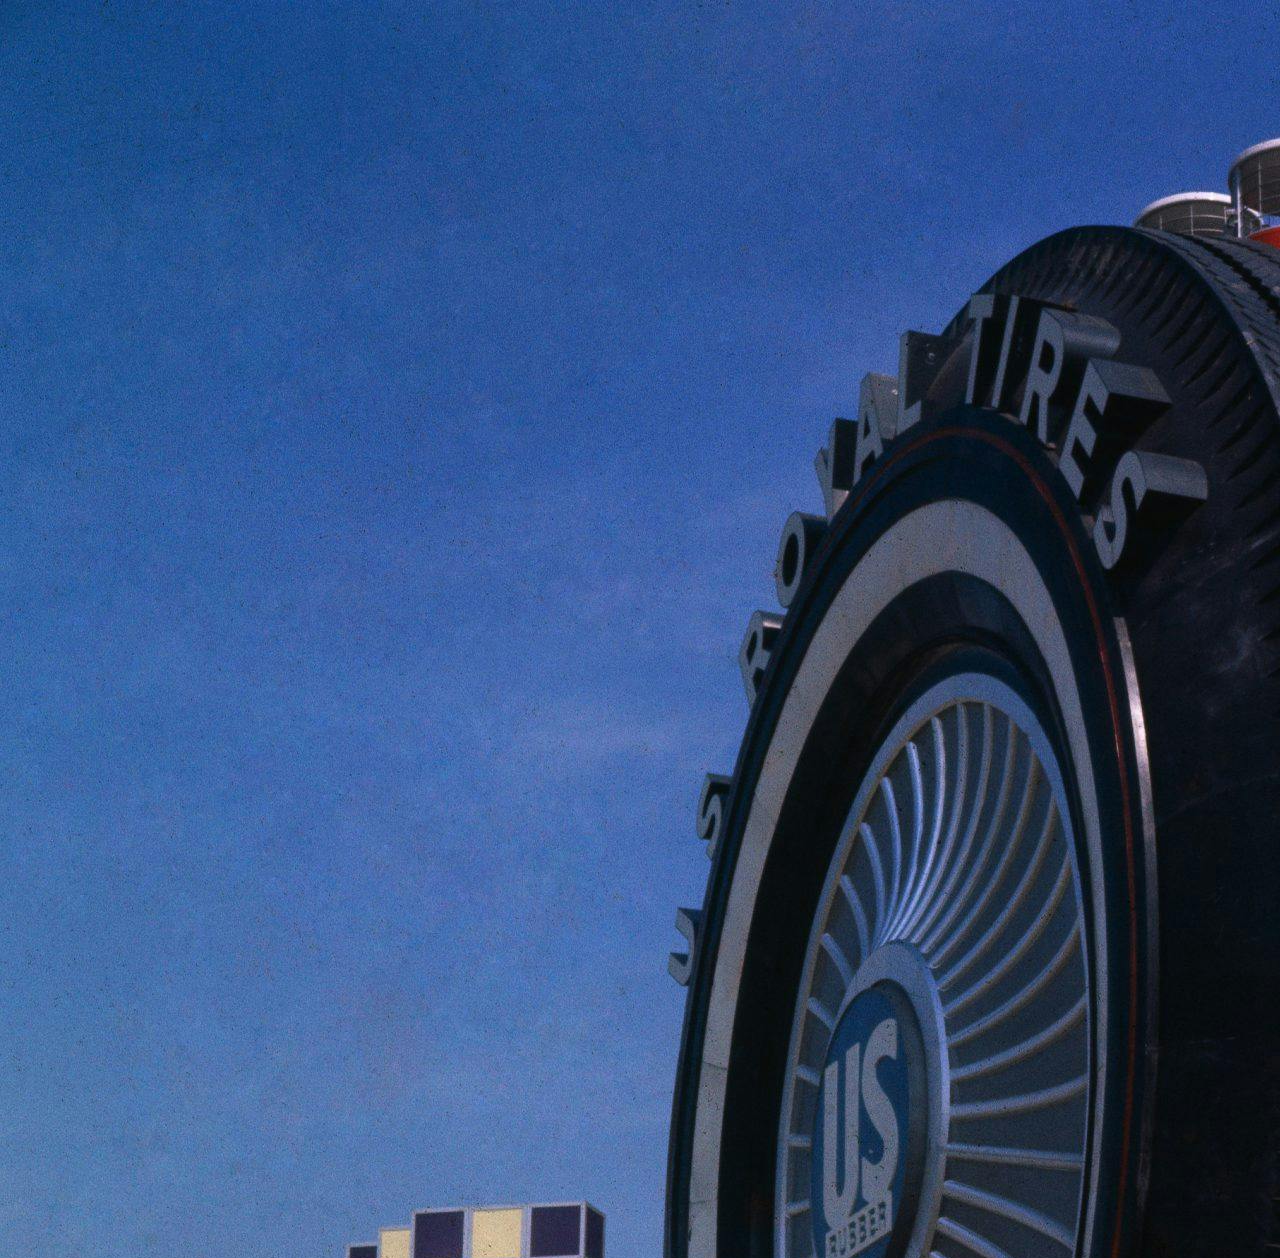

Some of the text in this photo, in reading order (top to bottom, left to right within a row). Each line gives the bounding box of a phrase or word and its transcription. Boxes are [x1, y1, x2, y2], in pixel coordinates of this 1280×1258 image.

[737, 331, 924, 712] ROYAL
[966, 293, 1148, 571] TIRES
[822, 1018, 899, 1229] US
[829, 1200, 887, 1257] RUBBER
